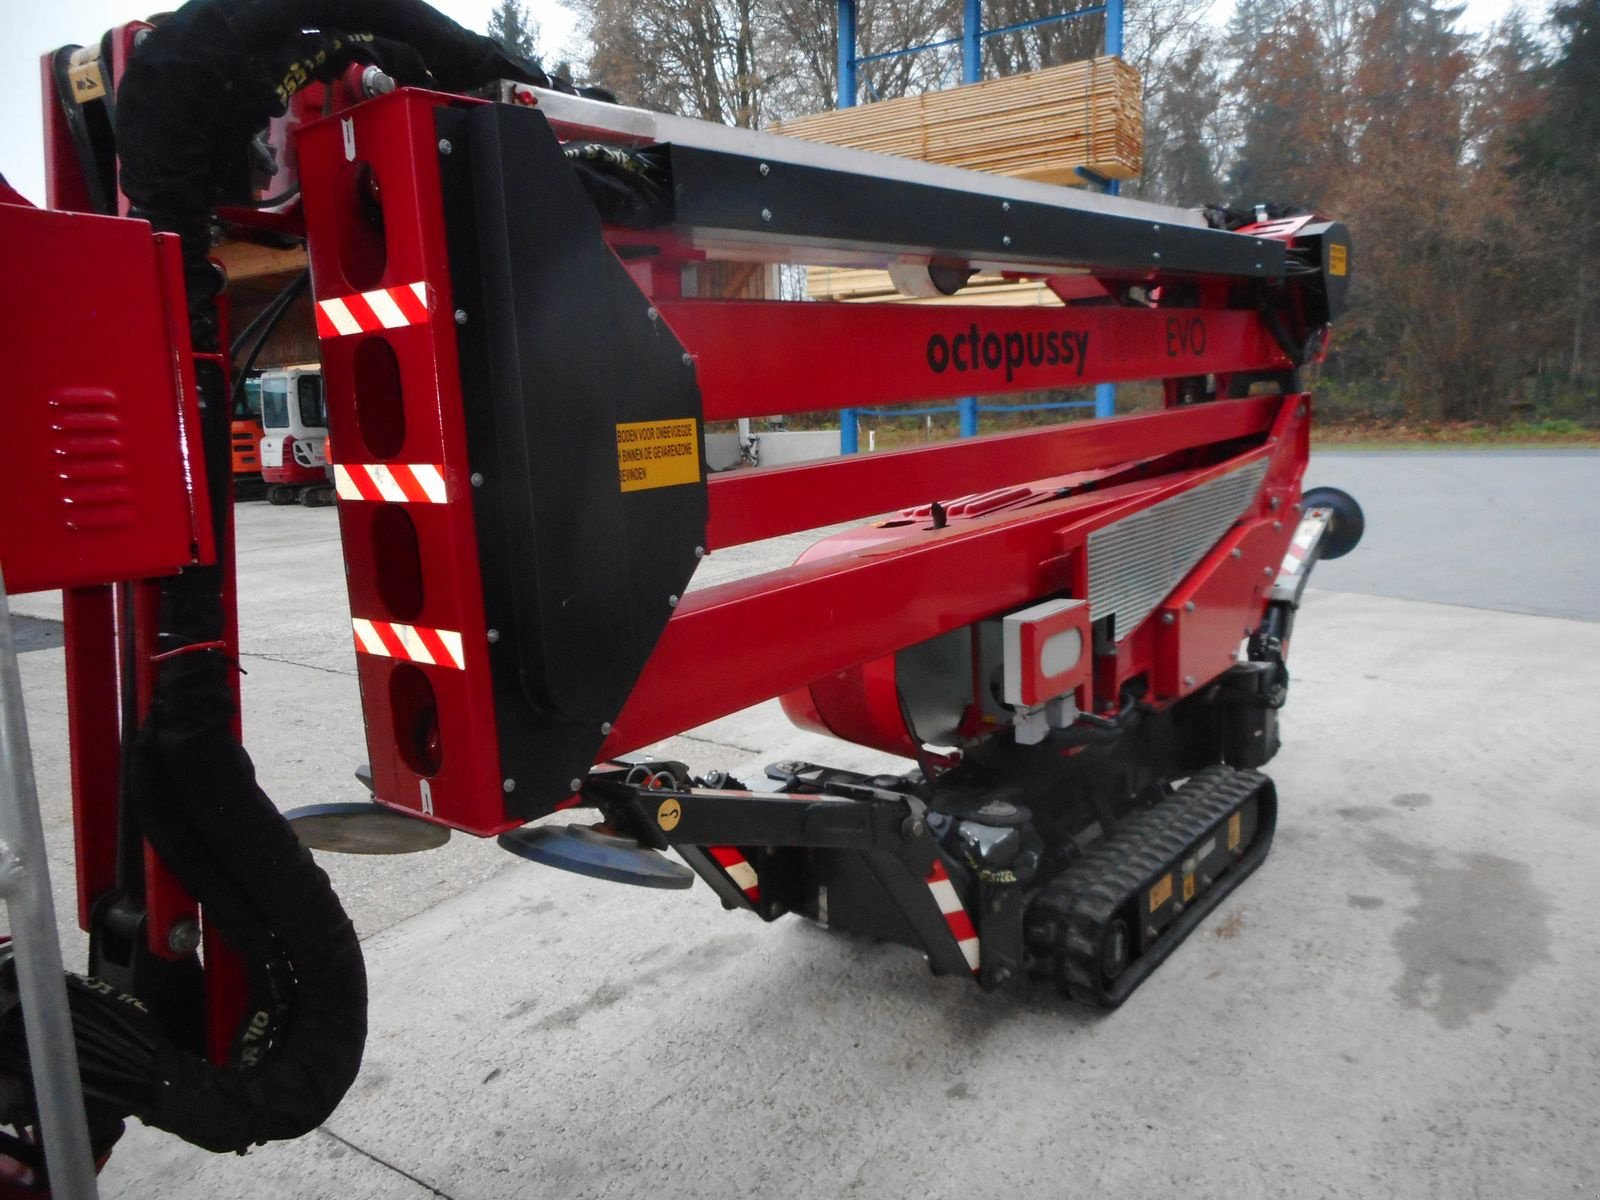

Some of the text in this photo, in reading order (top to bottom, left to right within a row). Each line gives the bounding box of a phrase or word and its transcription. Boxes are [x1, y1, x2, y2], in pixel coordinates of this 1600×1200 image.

[927, 323, 1089, 382] octopussy
[1166, 316, 1206, 358] EVO
[617, 424, 692, 443] BODEN VOOR ONBEVOEGDE
[622, 447, 644, 462] BINNEN
[644, 446, 653, 460] DE
[653, 443, 692, 459] GEVARENZONE
